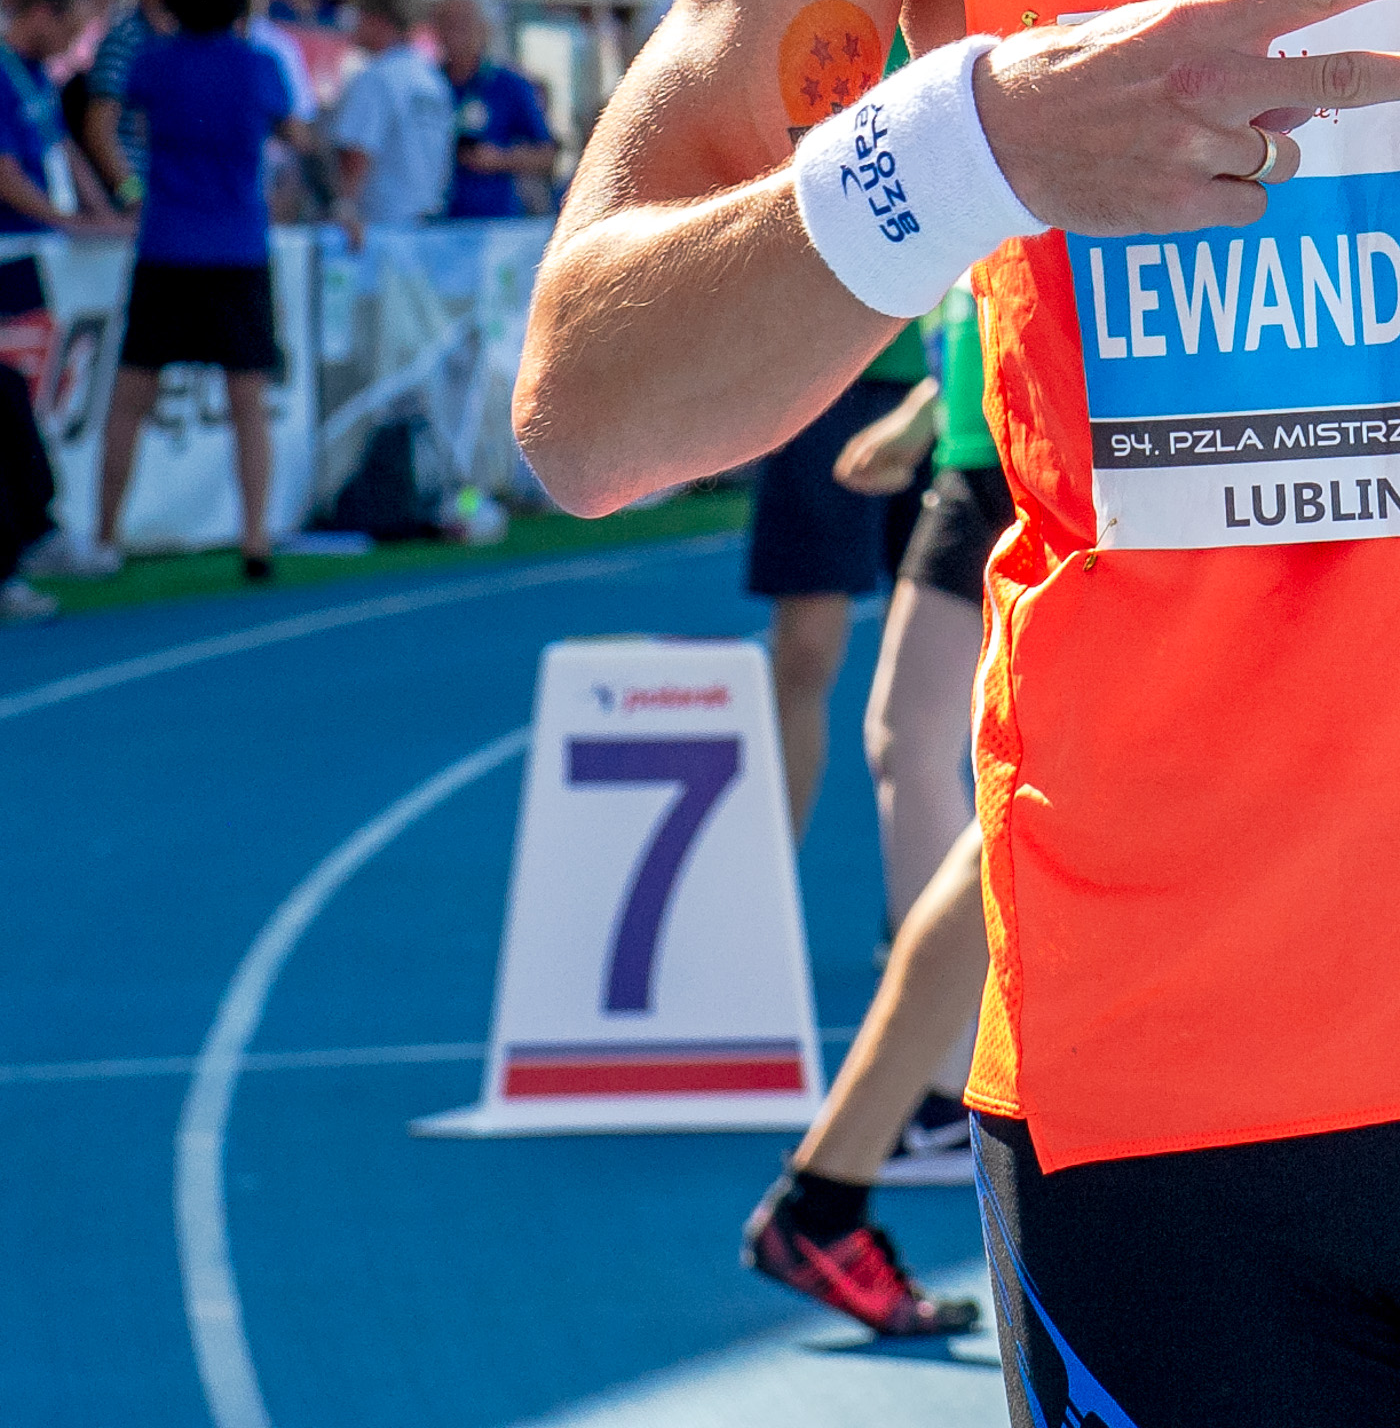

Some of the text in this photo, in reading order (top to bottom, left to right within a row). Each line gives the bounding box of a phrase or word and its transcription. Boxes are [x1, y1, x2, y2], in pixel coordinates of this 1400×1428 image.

[1111, 434, 1160, 457] 94.
[1169, 428, 1263, 455] PZLA
[566, 736, 745, 1013] 7
